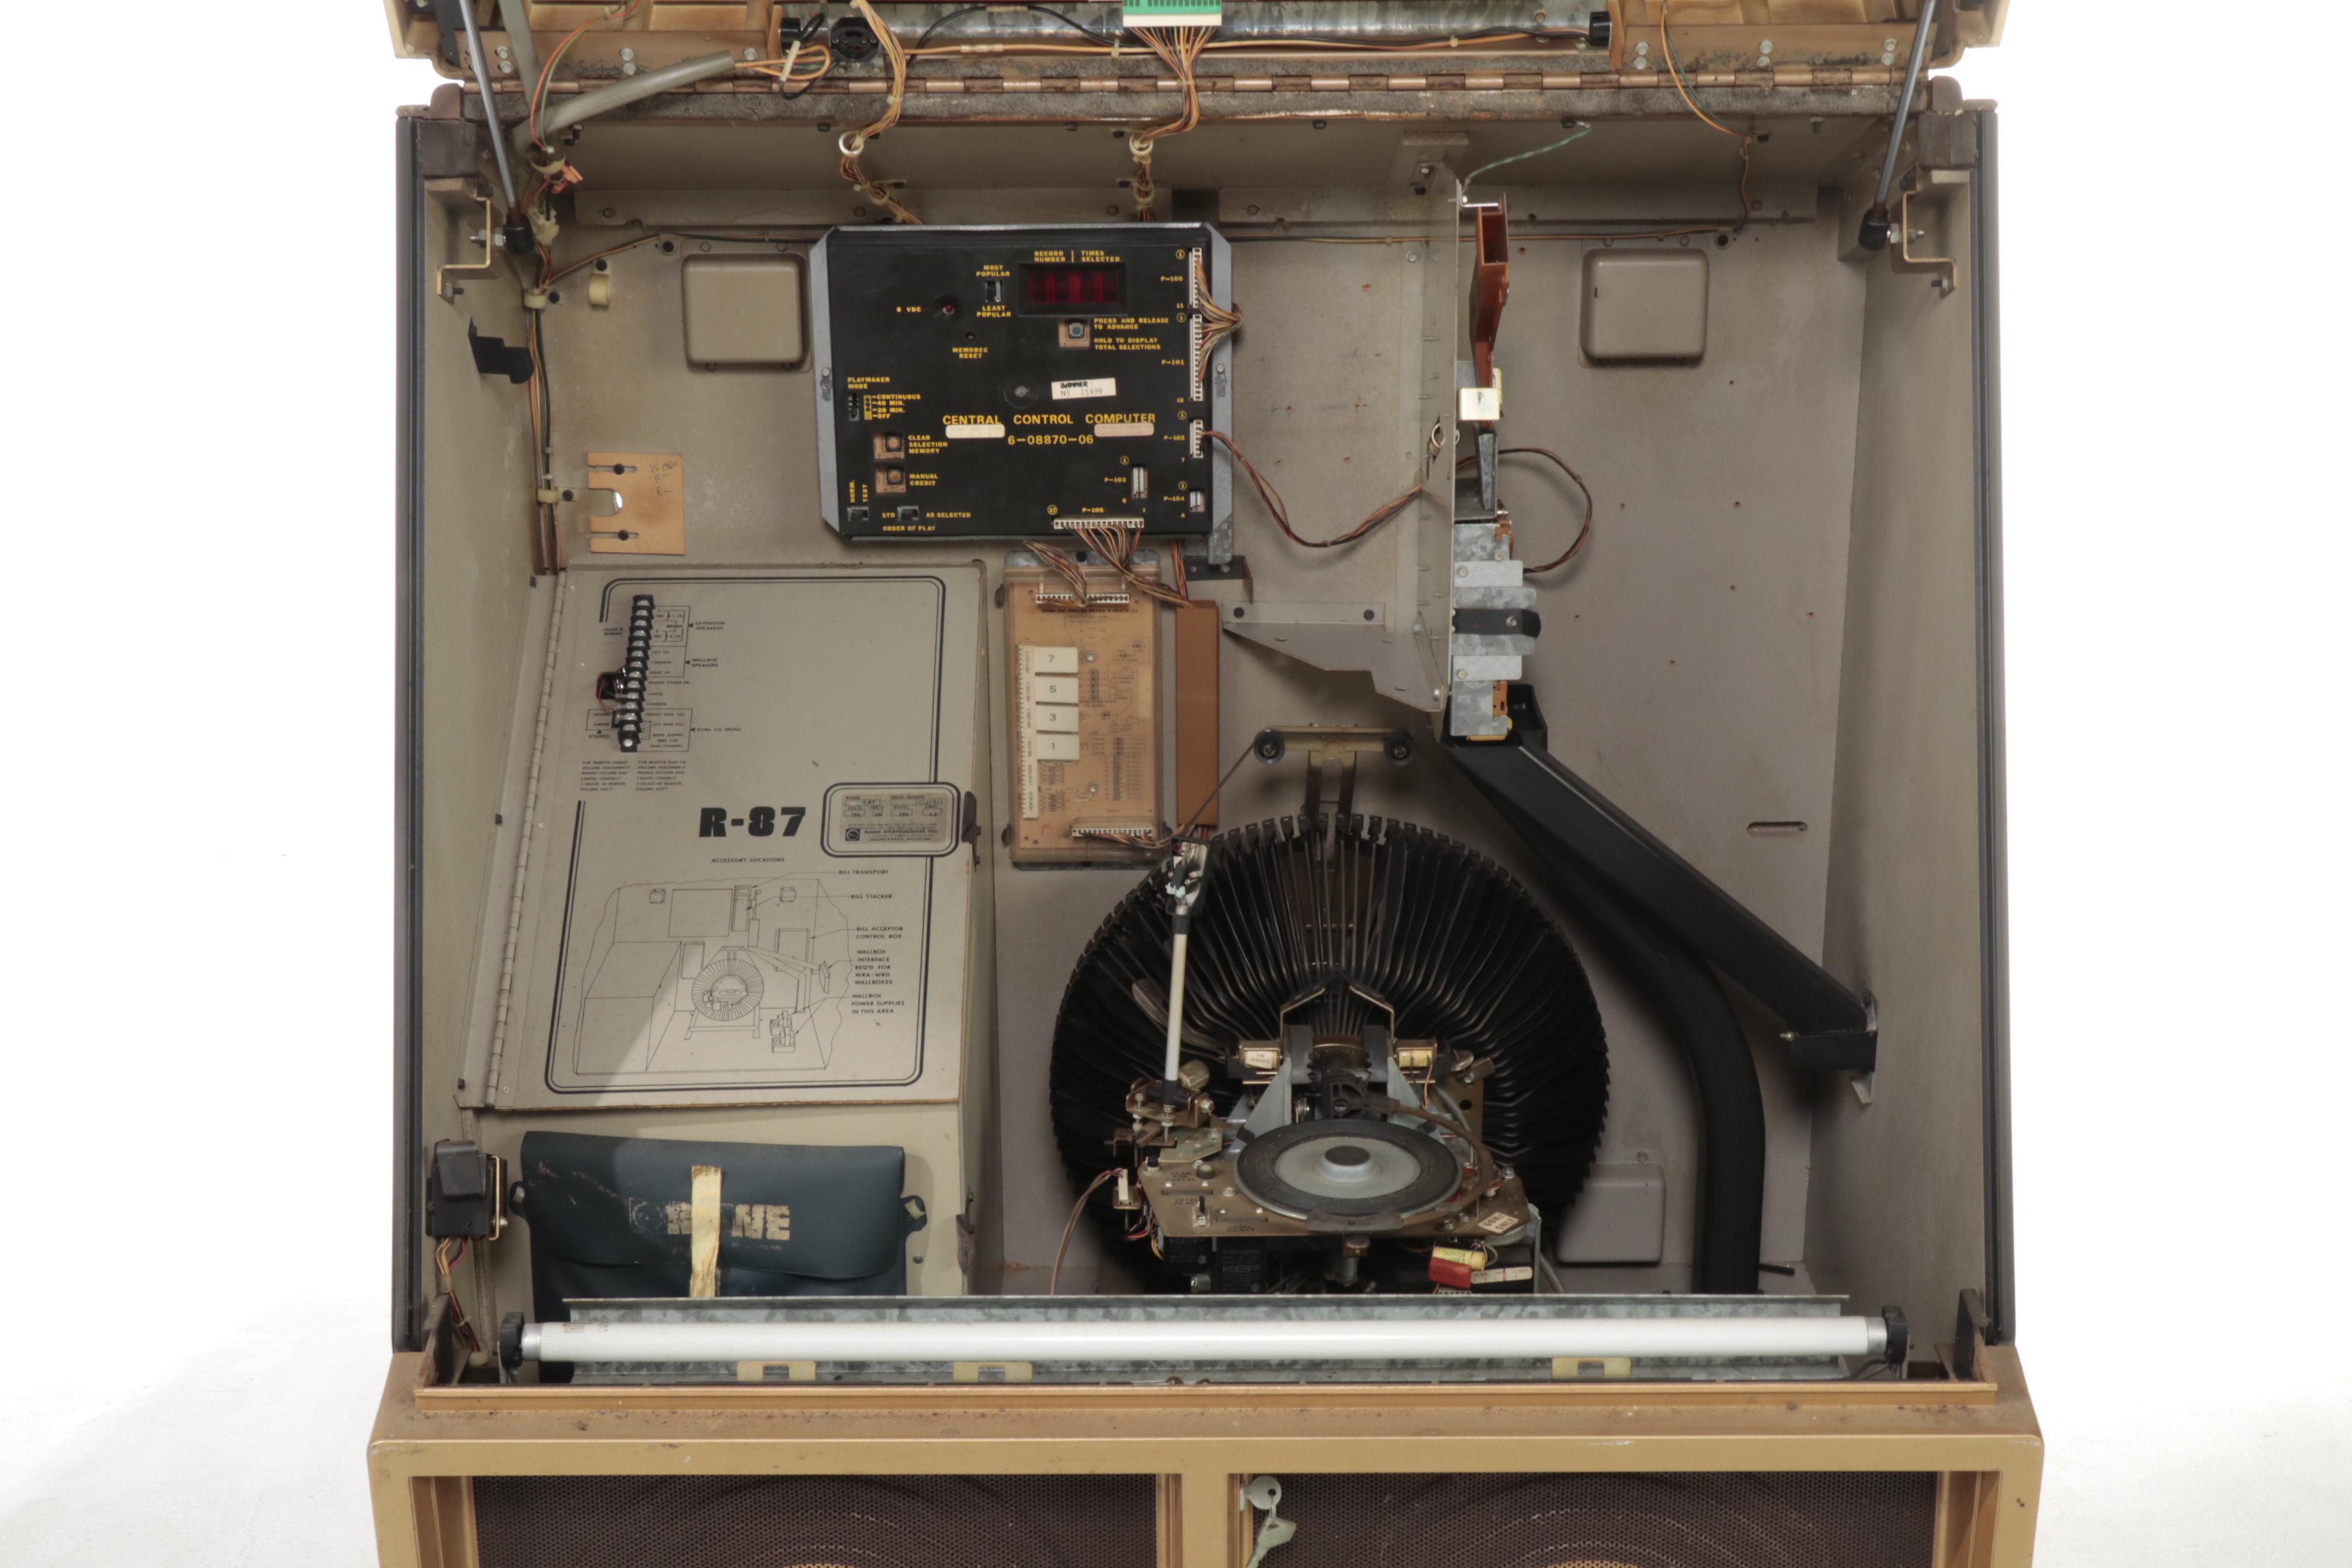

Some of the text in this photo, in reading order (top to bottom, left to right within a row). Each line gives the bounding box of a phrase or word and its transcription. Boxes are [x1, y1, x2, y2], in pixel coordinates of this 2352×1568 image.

[1060, 381, 1088, 389] BANNER
[943, 413, 1156, 426] CENTRAL CONTROL COMPUTER
[1008, 435, 1093, 445] 6-08870-06
[1050, 685, 1056, 693] 5
[1049, 713, 1056, 721] 3
[699, 806, 806, 838] R-87
